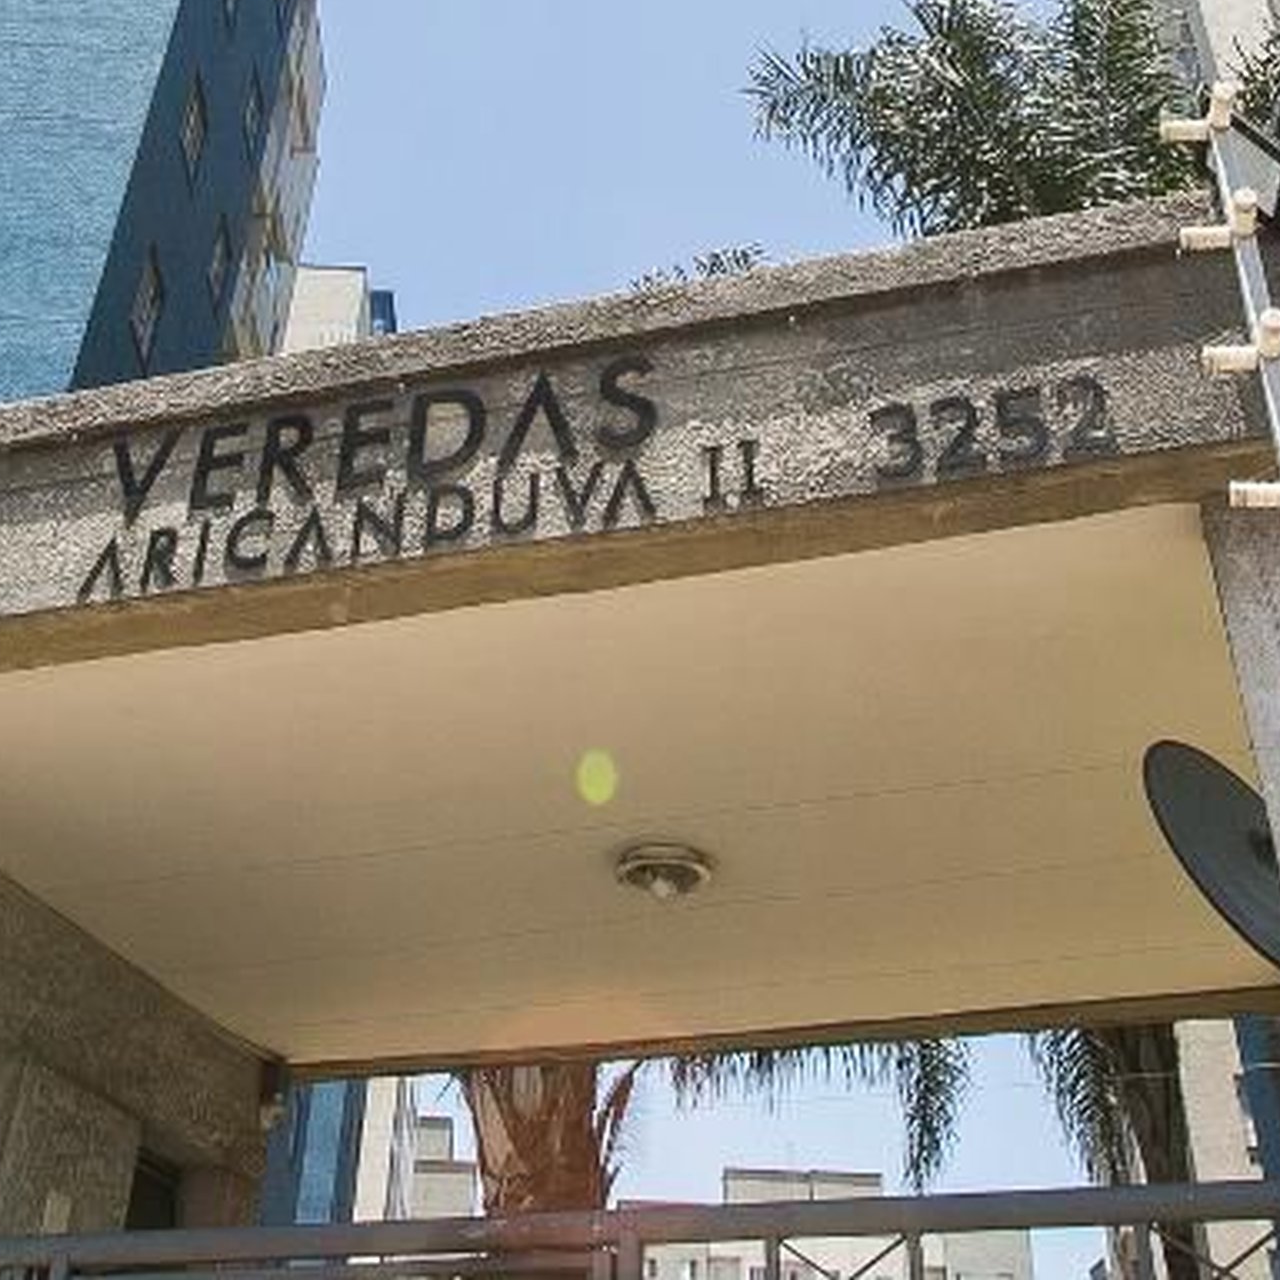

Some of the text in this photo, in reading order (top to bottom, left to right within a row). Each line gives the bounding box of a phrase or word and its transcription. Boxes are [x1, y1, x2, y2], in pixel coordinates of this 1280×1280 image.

[113, 357, 658, 527] VEREDAS
[870, 375, 1118, 478] 3252
[76, 458, 659, 602] ARICANDUVA
